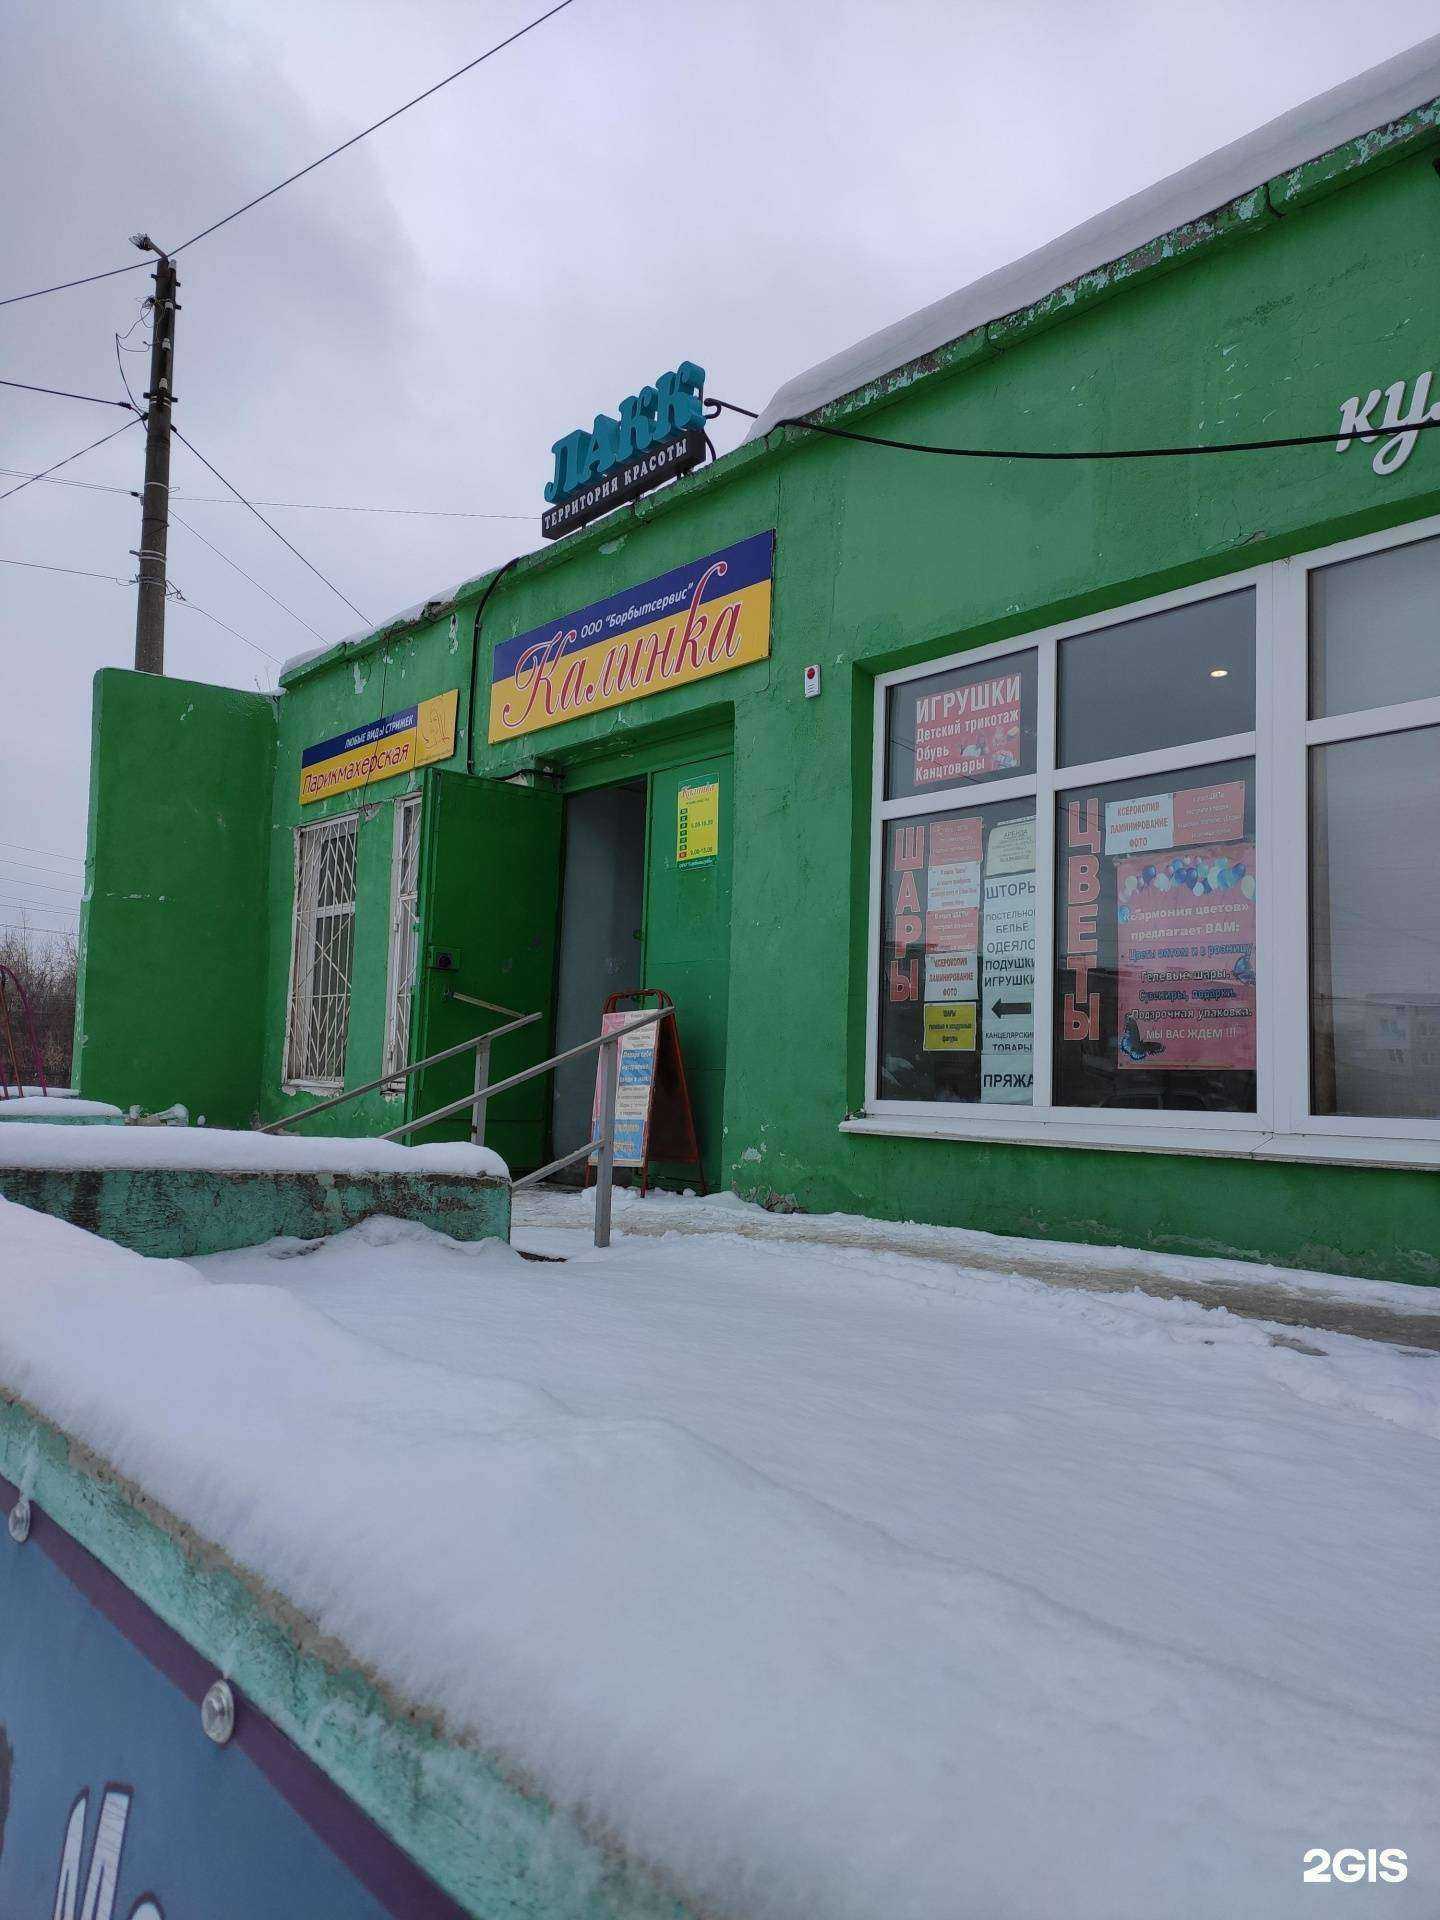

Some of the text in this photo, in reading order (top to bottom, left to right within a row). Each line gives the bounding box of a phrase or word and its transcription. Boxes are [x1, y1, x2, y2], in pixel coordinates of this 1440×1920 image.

[1336, 371, 1440, 475] ку
[544, 438, 687, 530] ТЕРРИТОРИЯ КРАСОТЫ
[502, 560, 743, 728] Калинка
[581, 619, 604, 638] ООО
[916, 675, 1021, 724] ИГРУШКИ
[916, 709, 1020, 744] Детский трикотаж
[302, 743, 410, 798] Парикмахерская
[915, 758, 985, 782] Канцтовары
[916, 747, 950, 762] Обувь
[1129, 837, 1148, 848] ФОТО
[986, 908, 1036, 921] ПОСТЕЛЬНО
[1064, 798, 1101, 1040] ЦВЕТЫ
[1146, 1029, 1163, 1040] МЫ
[1166, 1029, 1186, 1040] ВАС
